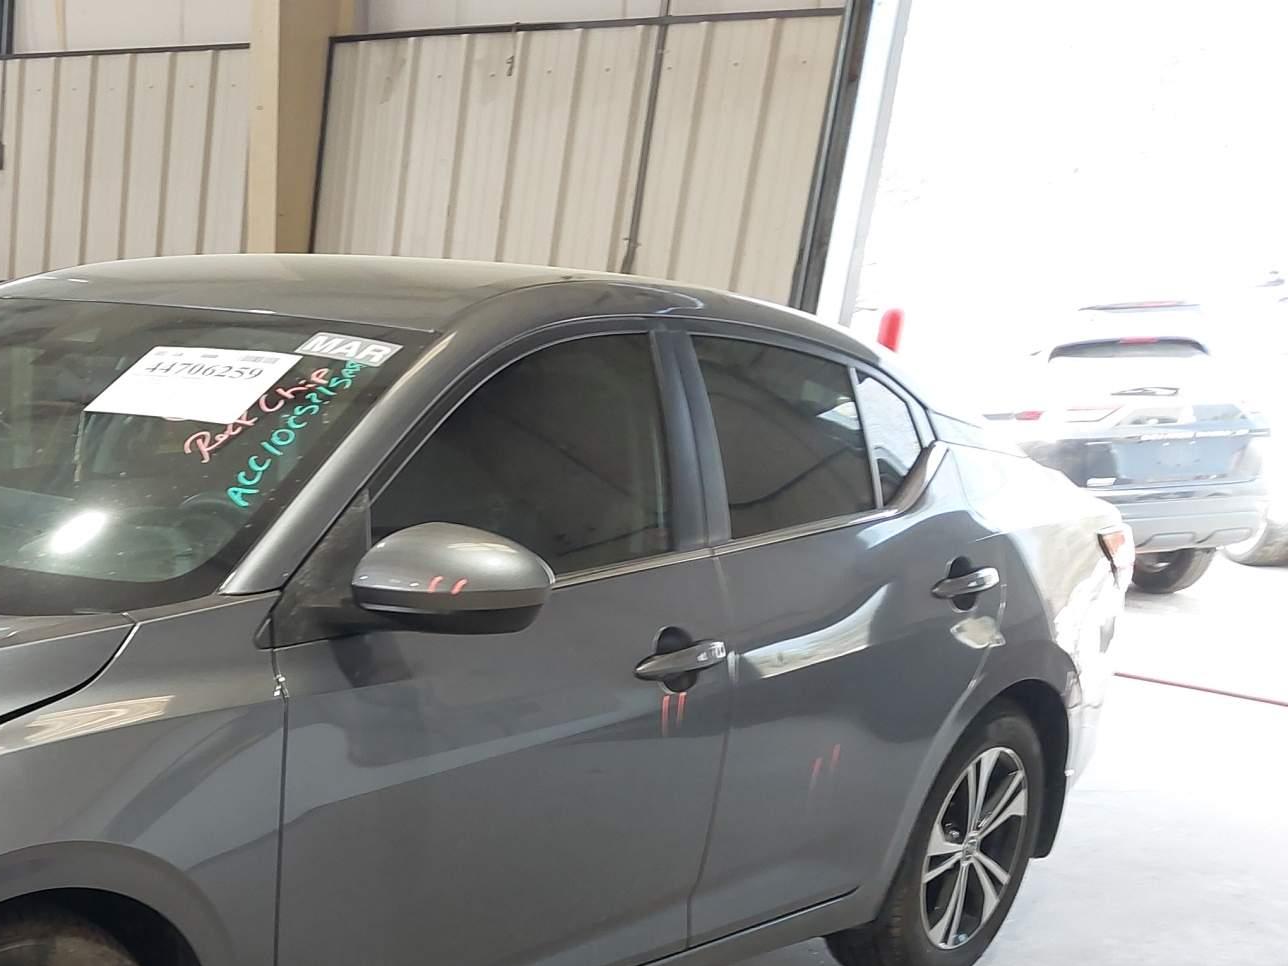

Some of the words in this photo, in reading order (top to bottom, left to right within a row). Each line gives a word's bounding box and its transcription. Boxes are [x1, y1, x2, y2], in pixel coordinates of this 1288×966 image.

[302, 335, 392, 363] MAR
[145, 361, 264, 380] 44706259
[227, 455, 272, 507] ACC
